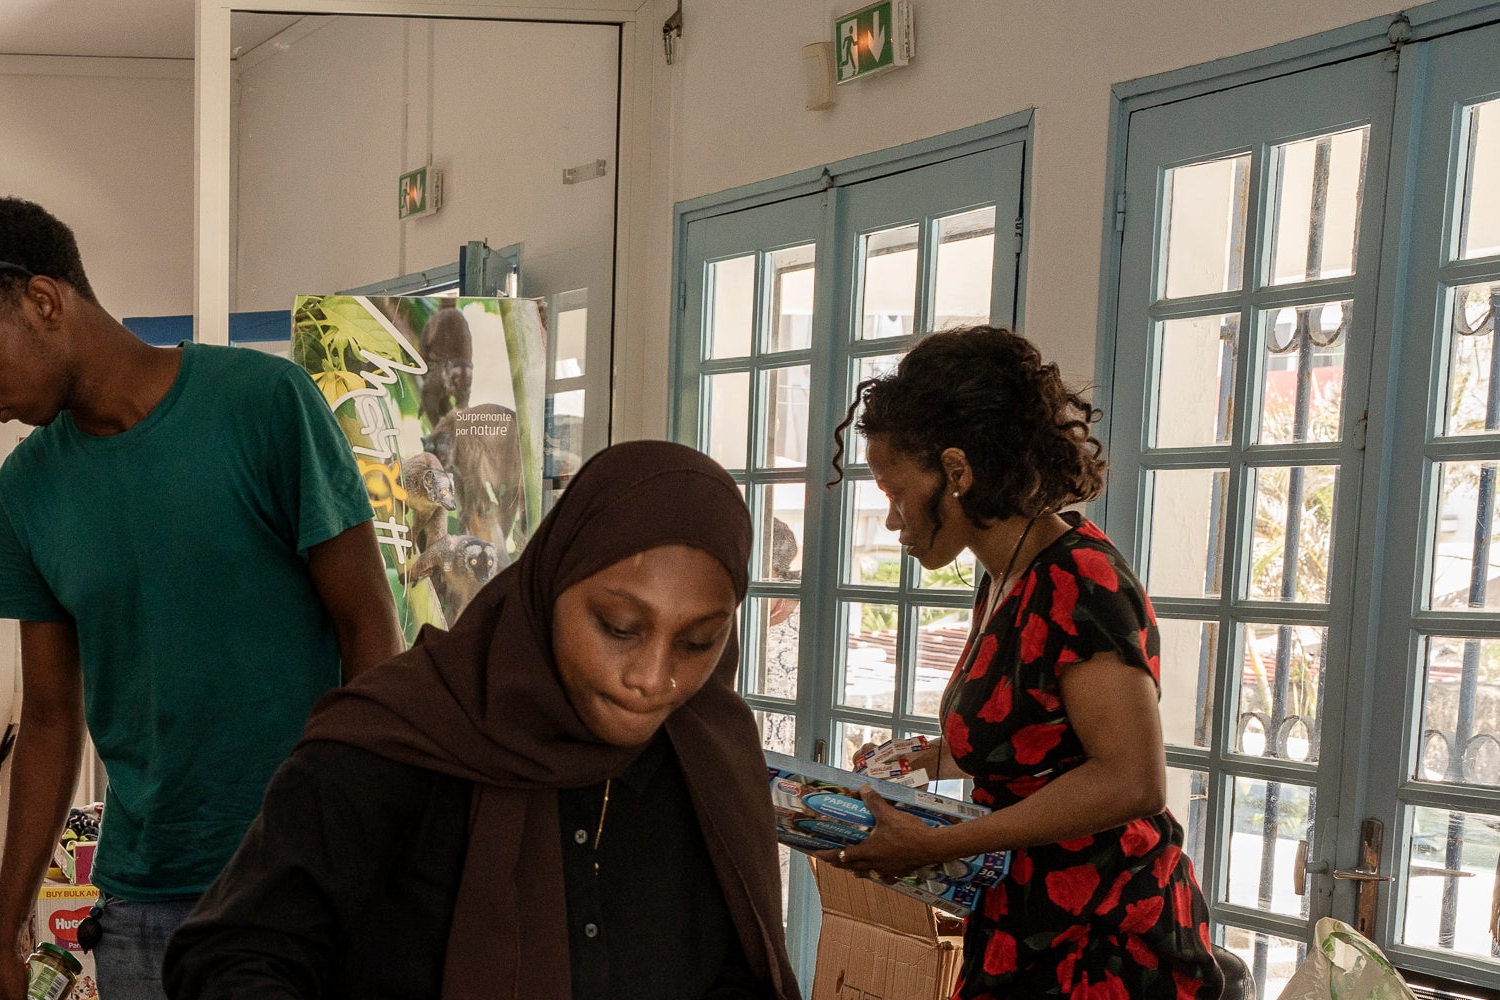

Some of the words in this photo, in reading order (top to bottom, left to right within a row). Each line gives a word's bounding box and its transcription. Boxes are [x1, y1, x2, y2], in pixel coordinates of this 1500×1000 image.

[456, 410, 512, 424] Surprenante
[455, 427, 469, 437] par
[470, 423, 508, 437] nature
[823, 796, 859, 810] PAPIER
[46, 890, 63, 898] BUY
[63, 890, 85, 898] BULK
